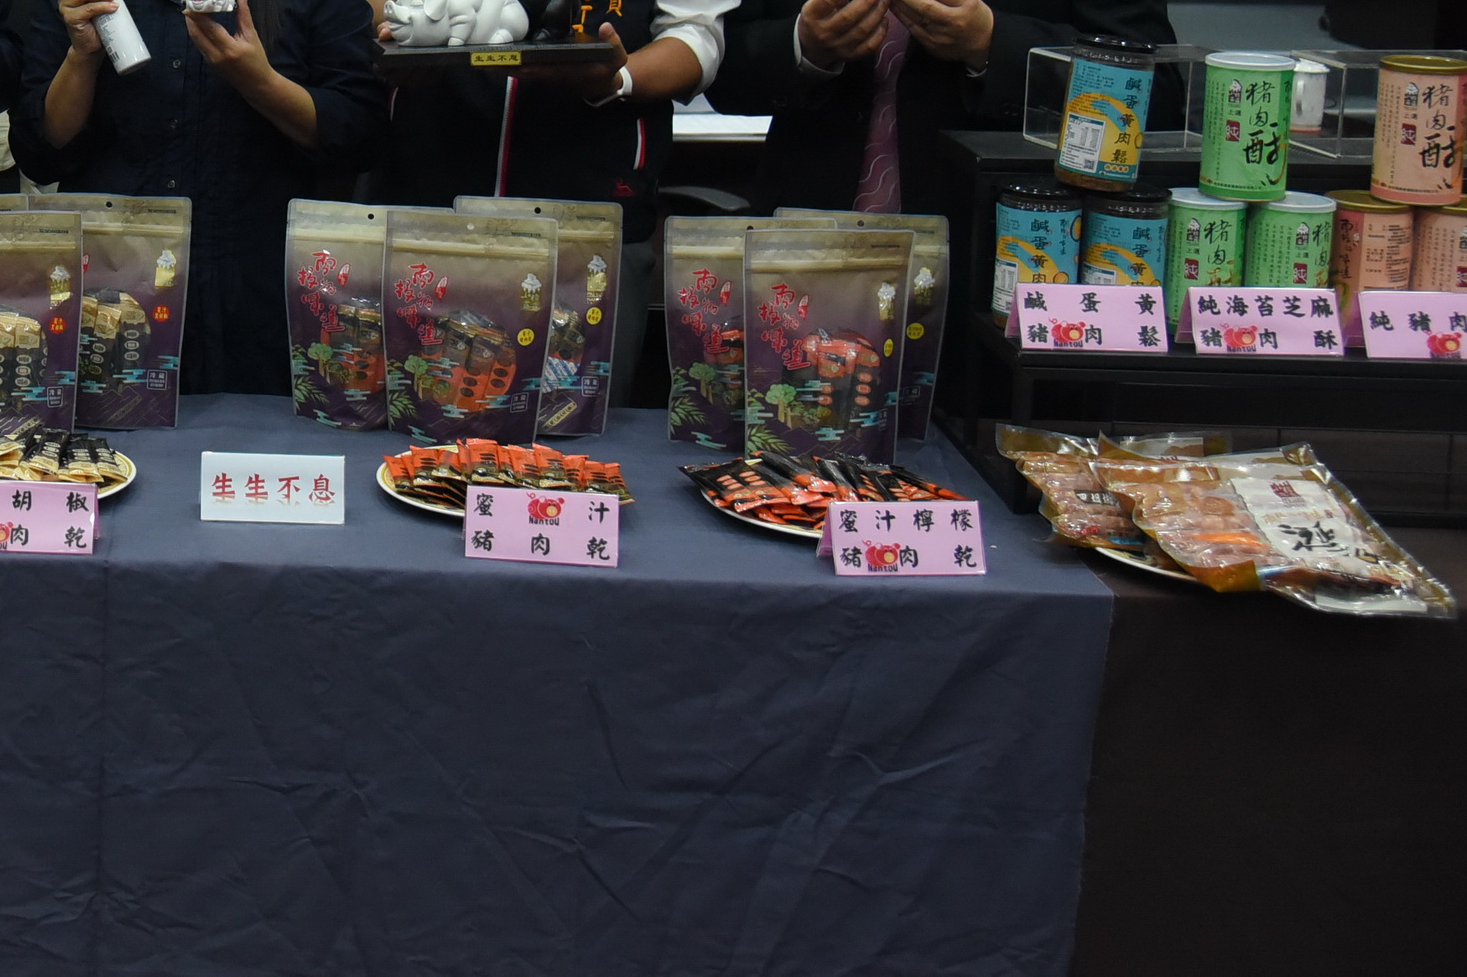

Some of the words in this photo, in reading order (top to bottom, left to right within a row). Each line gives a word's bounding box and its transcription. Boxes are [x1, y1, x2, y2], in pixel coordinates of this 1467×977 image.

[1111, 77, 1141, 163] 鹹蛋黃肉鬆
[1024, 291, 1157, 315] 鹹蛋黃
[1198, 295, 1333, 318] 純海苔芝麻
[1027, 323, 1161, 347] 豬肉鬆
[1200, 327, 1338, 350] 豬肉酥
[212, 473, 335, 502] 生生不息
[839, 509, 974, 533] 蜜汁檸檬
[471, 529, 610, 561] 豬肉乾
[840, 545, 977, 568] 豬肉乾
